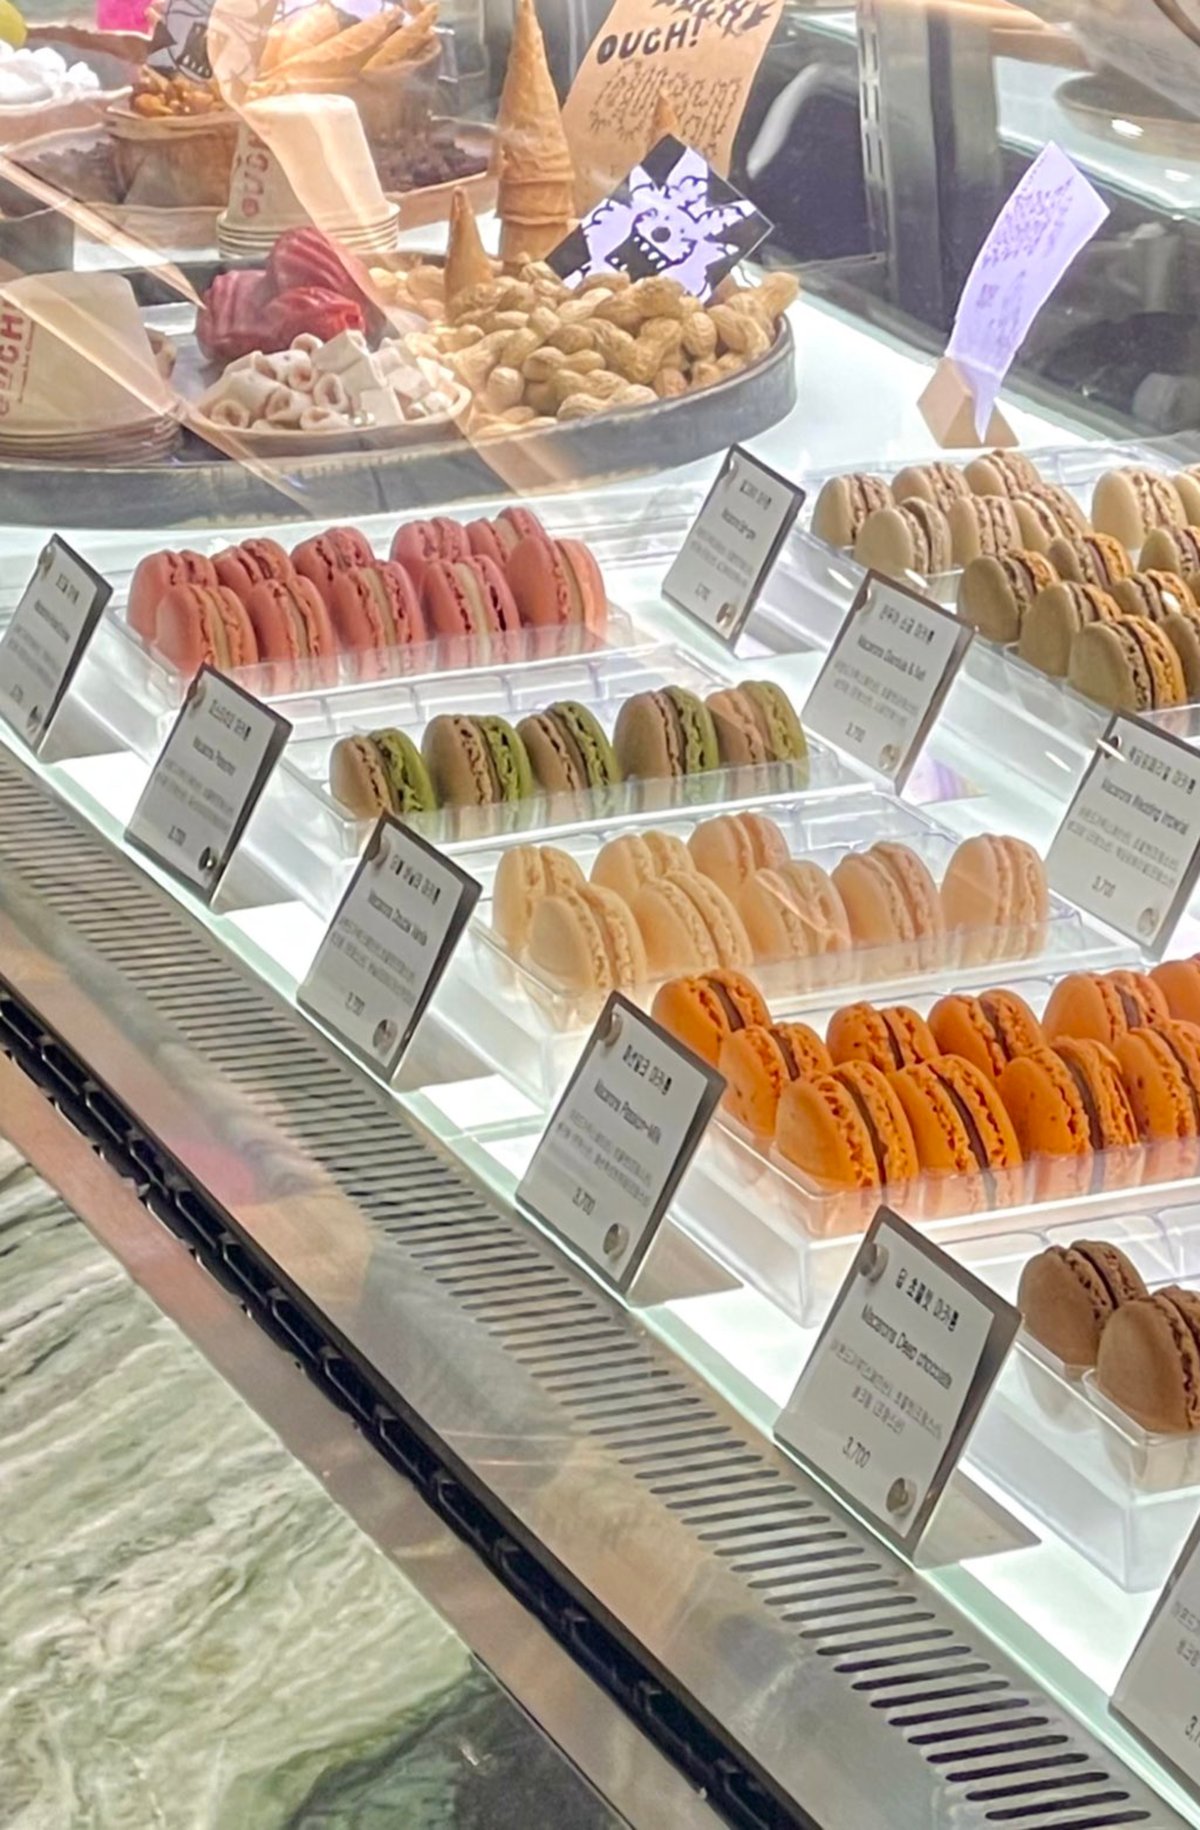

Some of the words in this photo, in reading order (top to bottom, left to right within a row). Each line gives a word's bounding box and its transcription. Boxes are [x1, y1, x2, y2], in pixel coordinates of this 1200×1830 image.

[1170, 770, 1196, 794] 마카롱
[592, 1078, 623, 1111] Macarons
[647, 1065, 673, 1096] 마카롱
[931, 1297, 960, 1332] 마카롱
[860, 1303, 898, 1343] Macarons
[895, 1332, 919, 1360] Deep
[841, 1435, 871, 1469] 3,700
